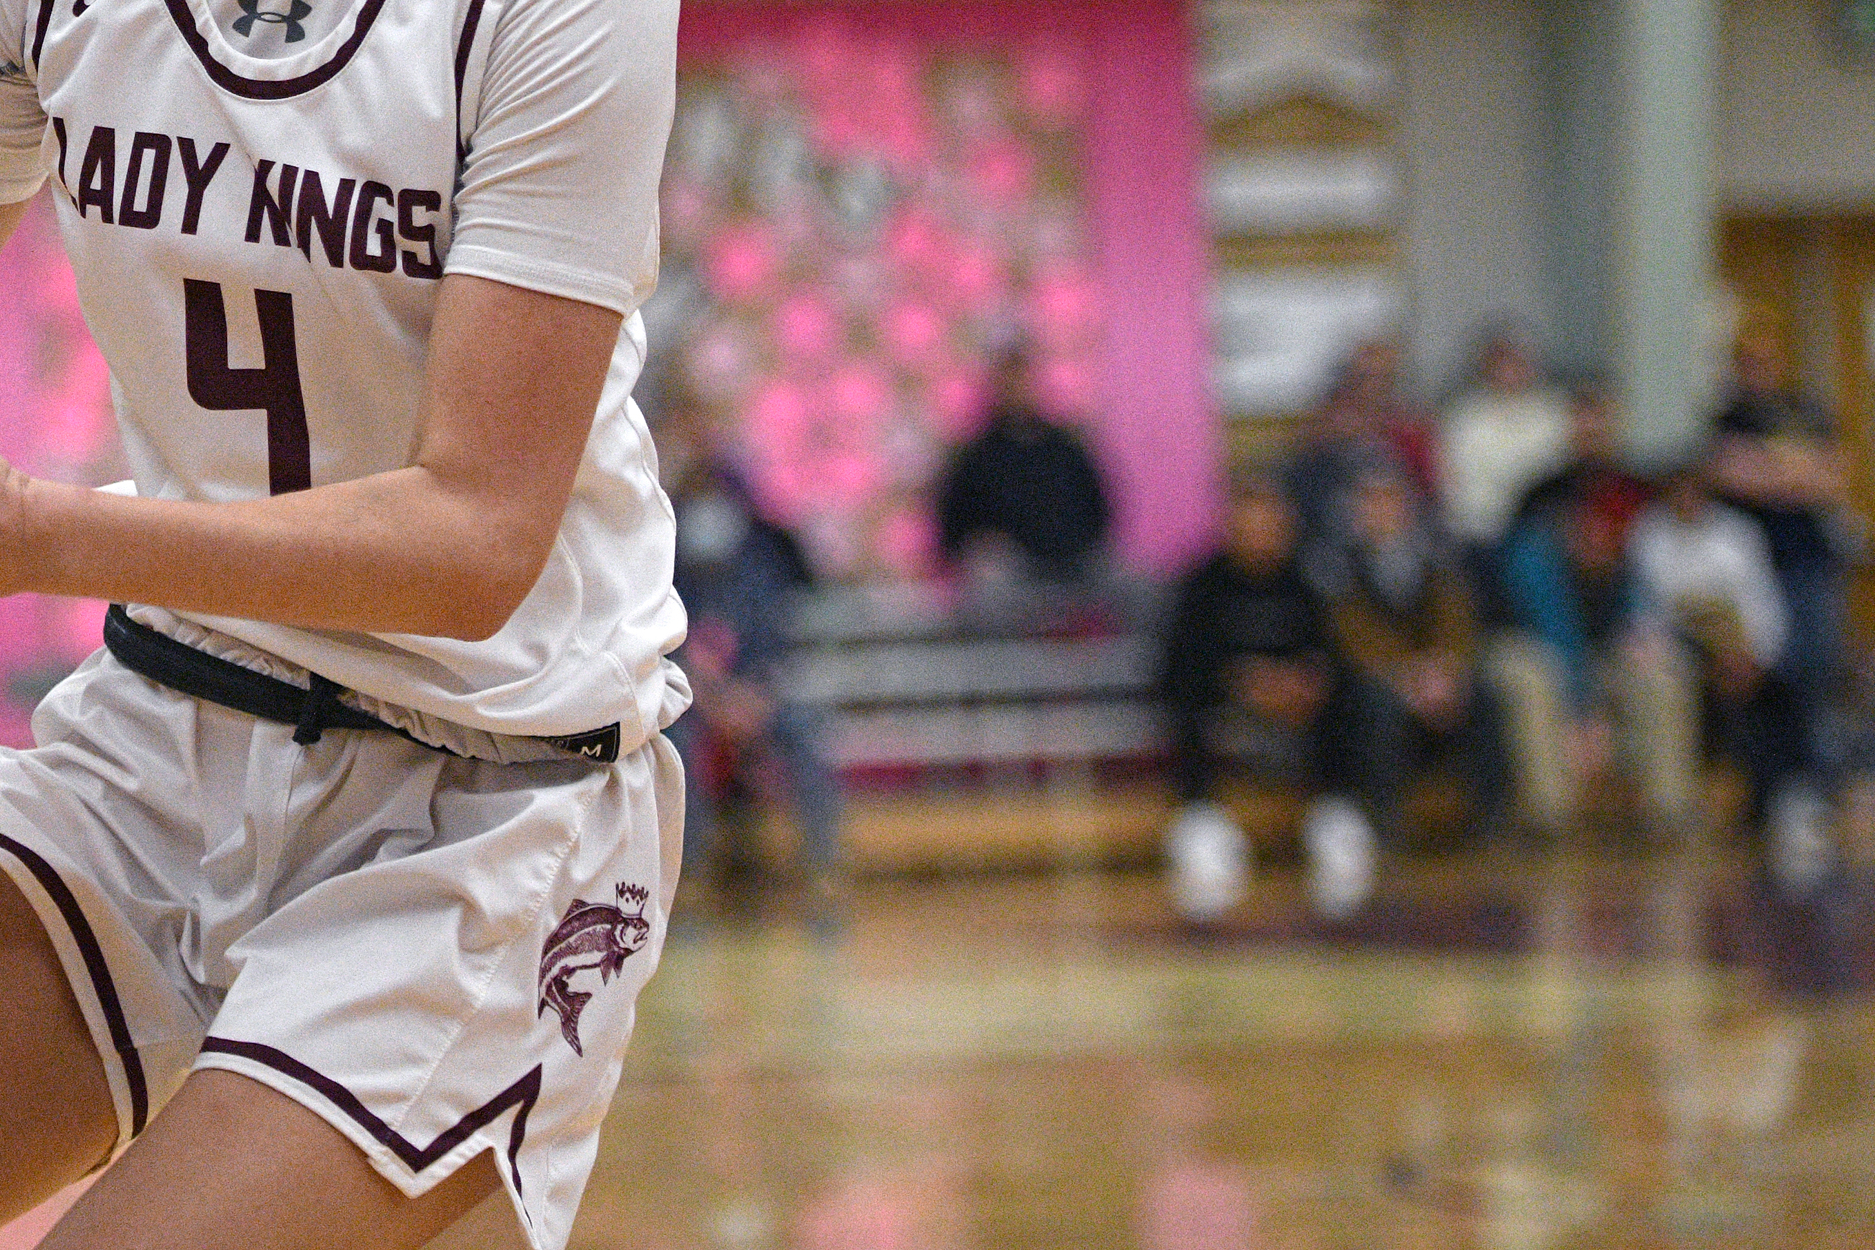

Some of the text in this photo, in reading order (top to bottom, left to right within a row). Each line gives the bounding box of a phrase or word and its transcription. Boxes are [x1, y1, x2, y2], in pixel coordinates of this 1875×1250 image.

[51, 115, 232, 237] LADY
[182, 277, 312, 497] 4
[579, 743, 603, 758] M
